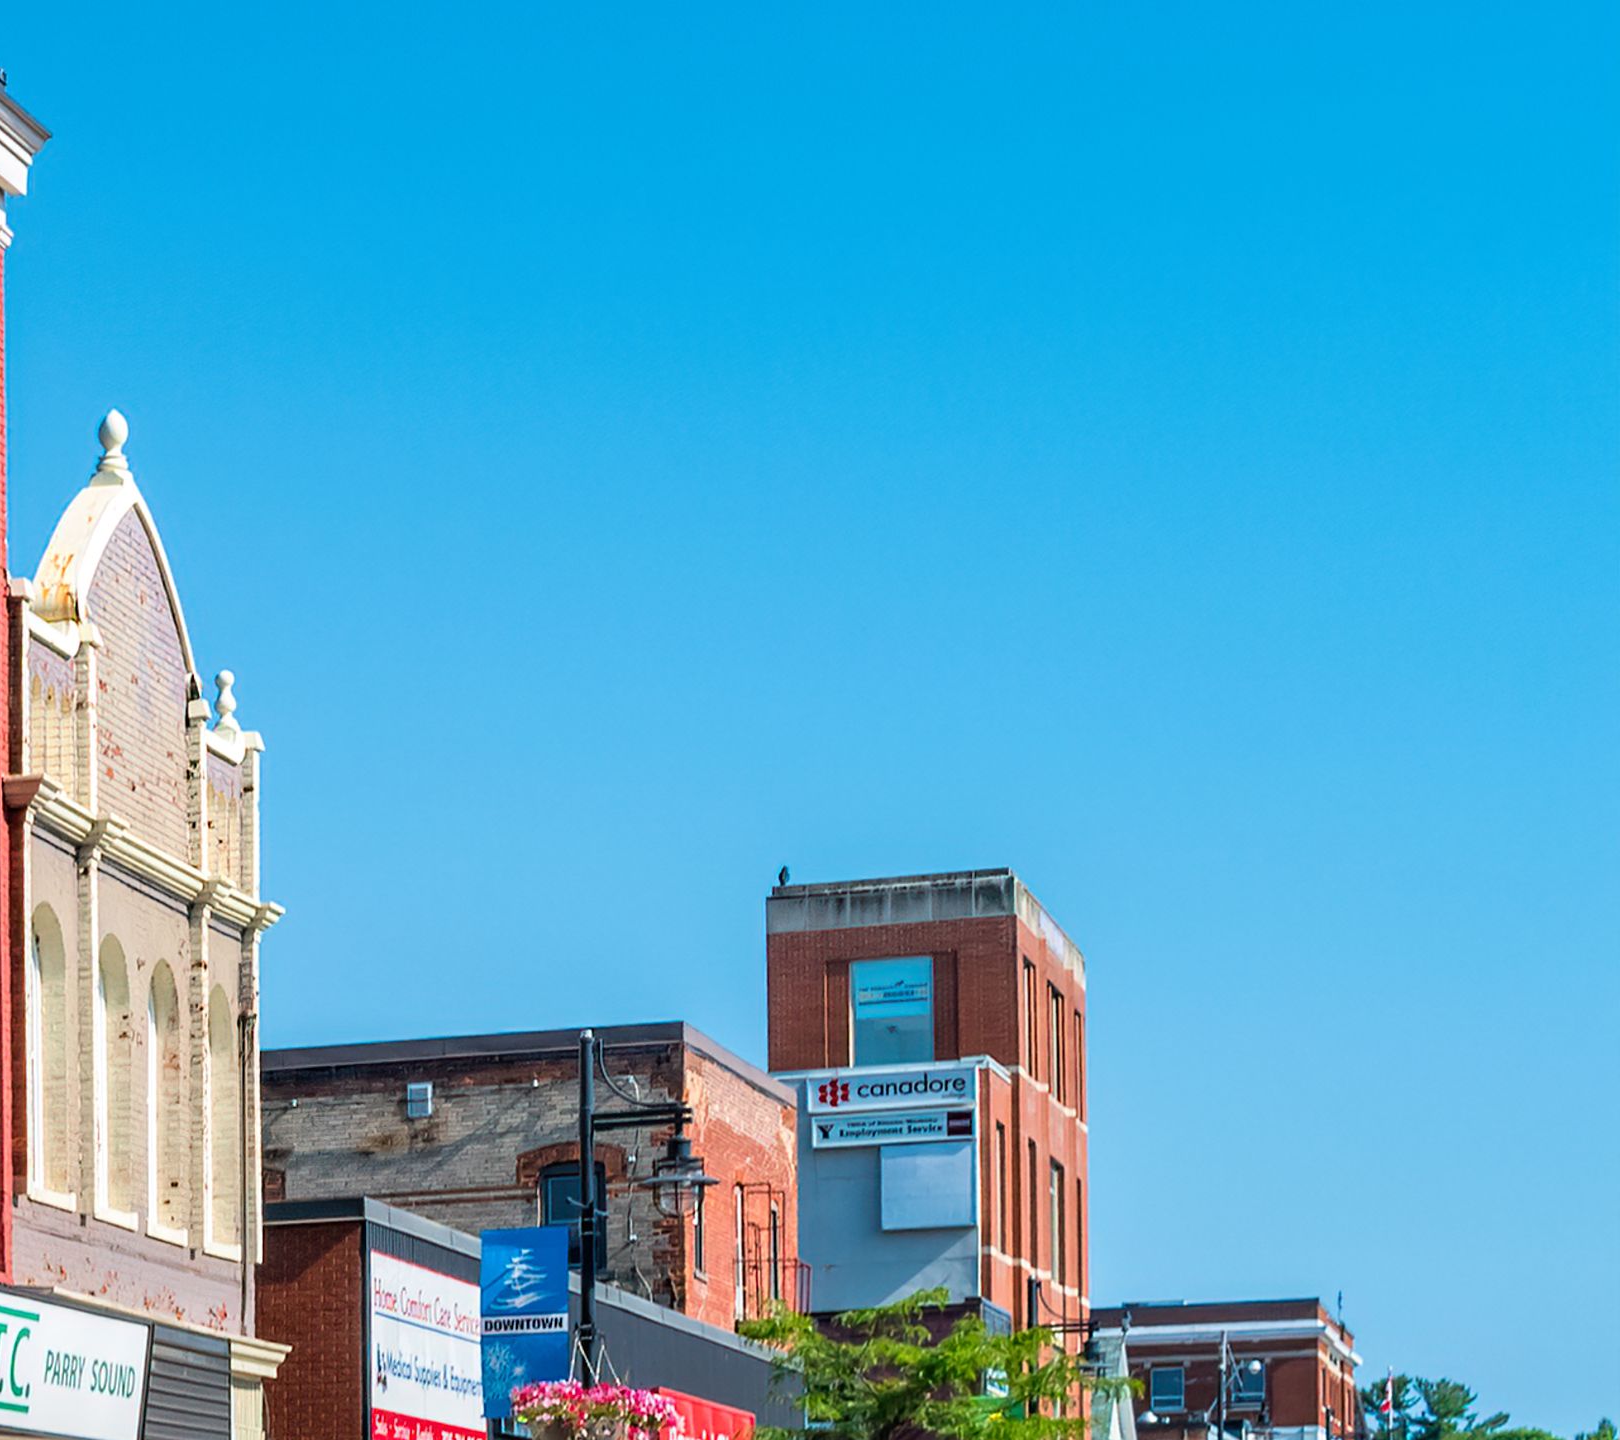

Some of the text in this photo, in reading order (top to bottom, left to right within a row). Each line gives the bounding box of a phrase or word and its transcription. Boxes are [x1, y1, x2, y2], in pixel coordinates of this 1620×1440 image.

[857, 1072, 966, 1099] canadore
[374, 1277, 398, 1312] Home
[400, 1286, 433, 1324] Comfort
[434, 1296, 452, 1329] Care
[484, 1316, 564, 1333] DOWNTOWN
[45, 1353, 136, 1400] PARRY SOUND
[386, 1350, 412, 1380] Medical
[413, 1356, 441, 1390] Supplies
[443, 1364, 449, 1389] &
